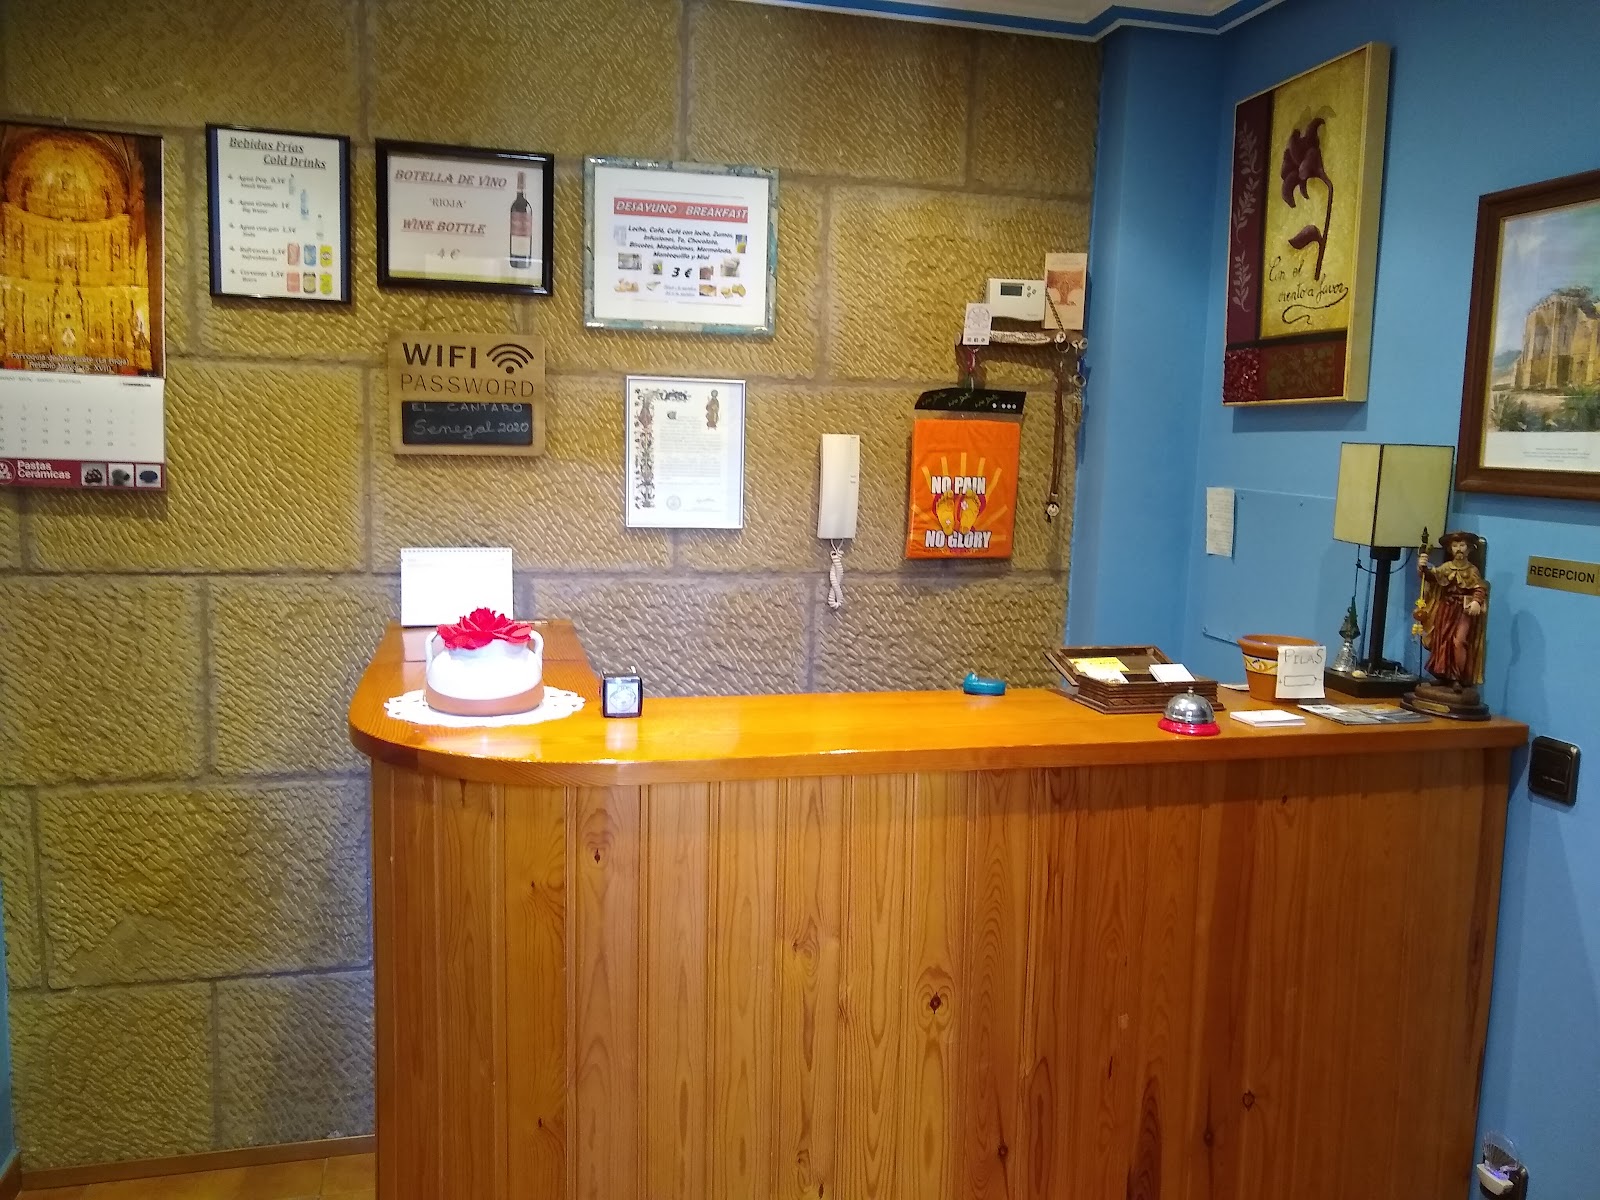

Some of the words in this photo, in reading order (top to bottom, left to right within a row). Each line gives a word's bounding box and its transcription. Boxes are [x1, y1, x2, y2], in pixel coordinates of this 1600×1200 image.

[229, 137, 274, 151] Bebidas
[263, 154, 288, 166] Cold
[289, 156, 327, 170] Drinks
[394, 169, 454, 184] BOTELLA
[457, 174, 475, 186] DE
[478, 175, 507, 188] VINO
[616, 200, 677, 215] DESAYUNO
[685, 205, 748, 220] BREAKFAST
[402, 218, 434, 232] WINE
[437, 221, 487, 235] BOTTLE
[671, 267, 681, 278] 3
[684, 267, 693, 278] €
[402, 342, 477, 369] WIFI
[401, 373, 534, 398] PASSWORD
[411, 403, 434, 412] EL
[413, 419, 495, 439] Senegal
[497, 421, 529, 434] 2020
[17, 460, 52, 471] Pastas
[931, 476, 952, 495] NO
[955, 476, 986, 495] PAIN
[925, 530, 946, 549] NO
[948, 531, 992, 549] GLORY
[1529, 565, 1595, 583] RECEPCION
[1284, 648, 1324, 666] PILAS
